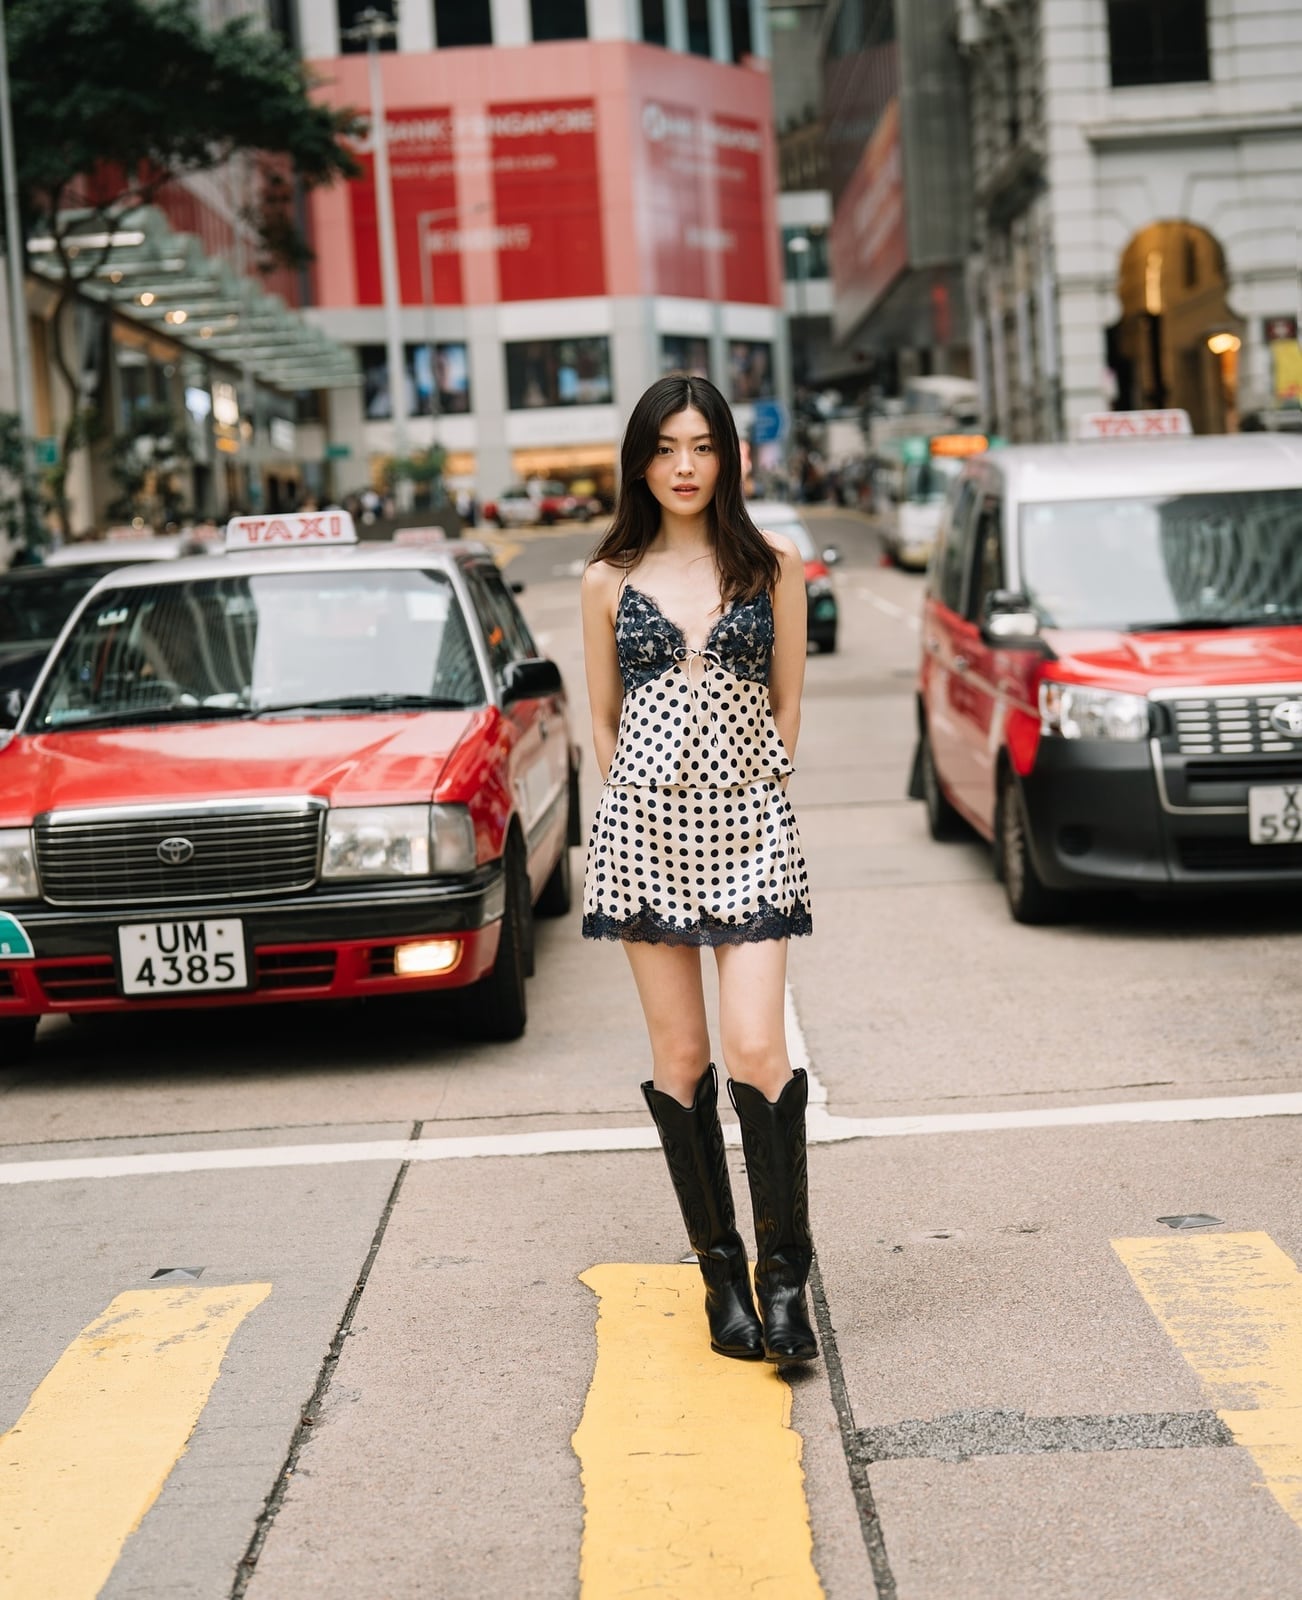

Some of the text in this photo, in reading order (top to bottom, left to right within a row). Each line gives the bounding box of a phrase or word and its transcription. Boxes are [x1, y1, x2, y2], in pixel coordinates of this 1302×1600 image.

[1090, 415, 1180, 434] TAXI
[239, 516, 341, 542] TAXI
[155, 922, 208, 954] UM
[135, 952, 236, 987] 4385
